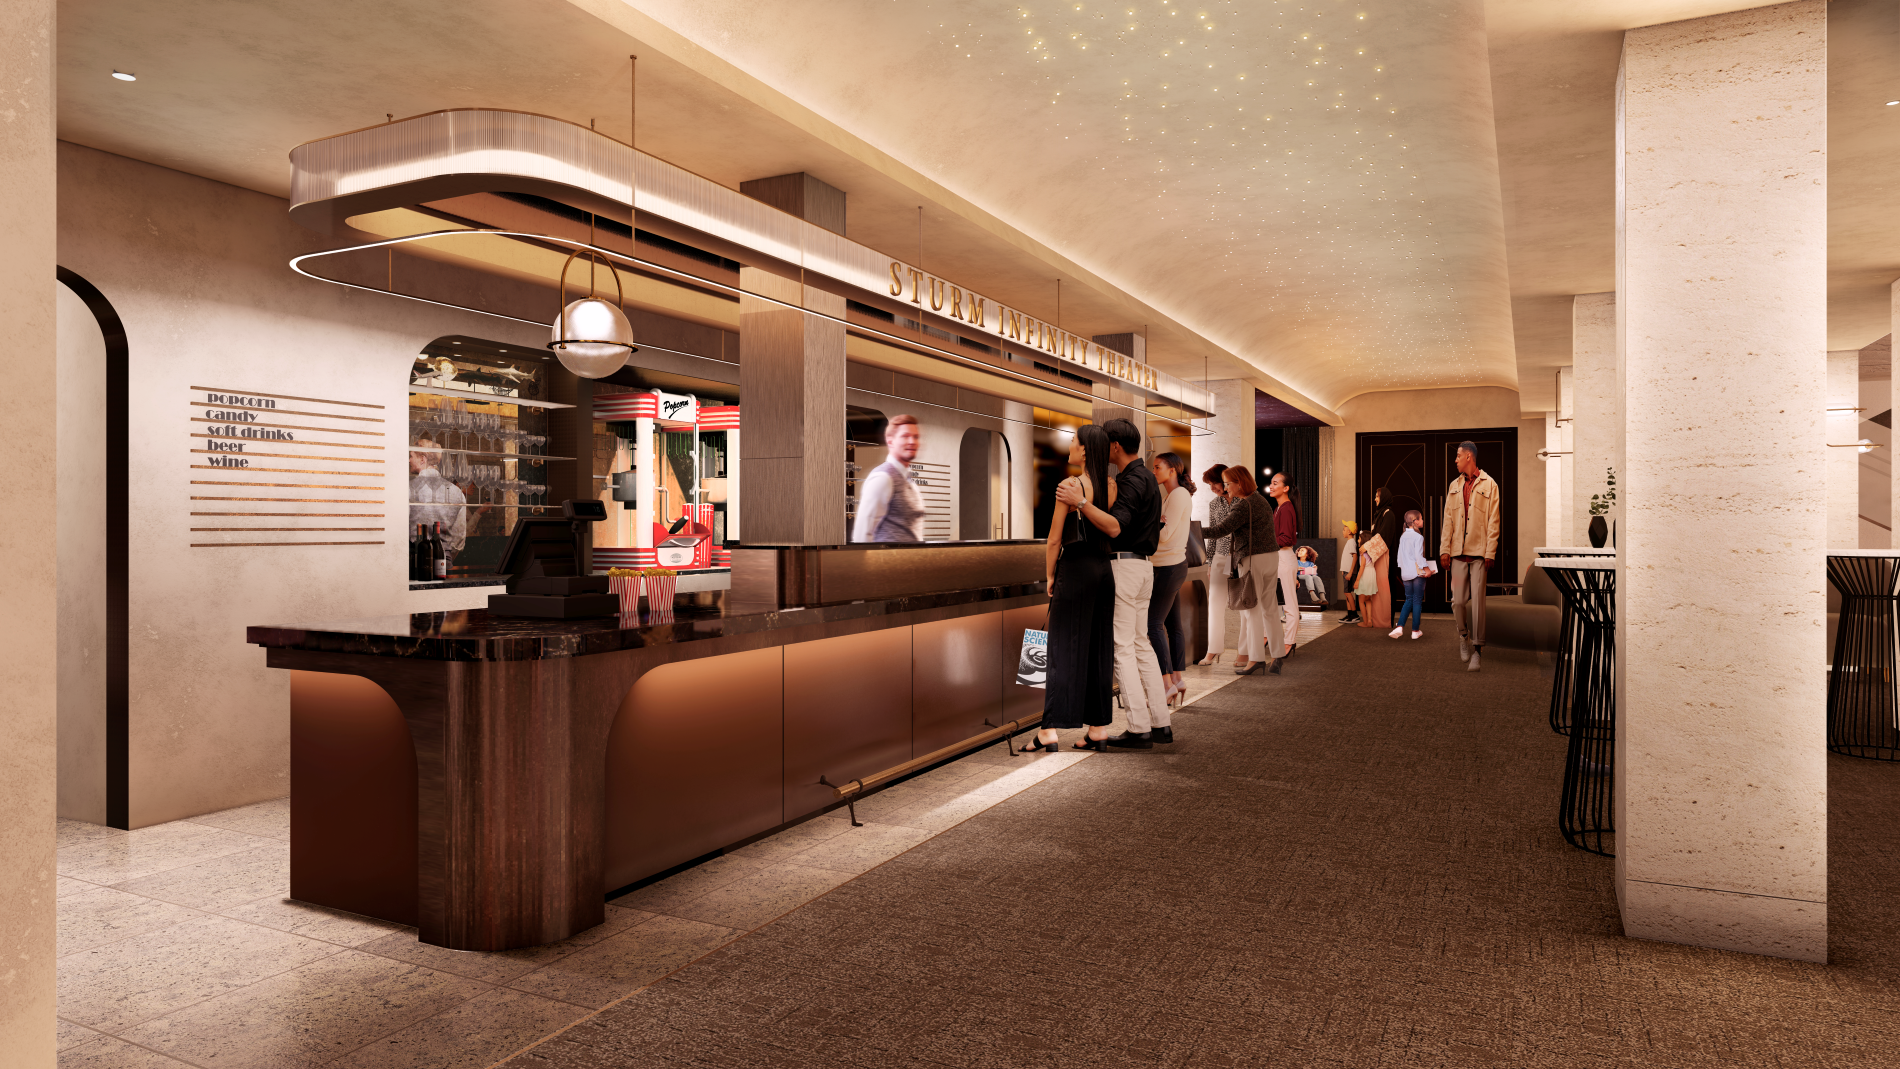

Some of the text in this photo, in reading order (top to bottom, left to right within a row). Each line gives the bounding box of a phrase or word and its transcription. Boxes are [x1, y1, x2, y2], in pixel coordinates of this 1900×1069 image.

[889, 261, 1159, 391] STURM INFINITY THEATER
[207, 393, 276, 409] popcorn
[663, 399, 690, 413] Popcorn
[205, 409, 259, 423] candy
[207, 425, 294, 440] soft drinks
[207, 439, 247, 453] beer
[207, 455, 249, 468] wine
[1025, 629, 1048, 639] NATU
